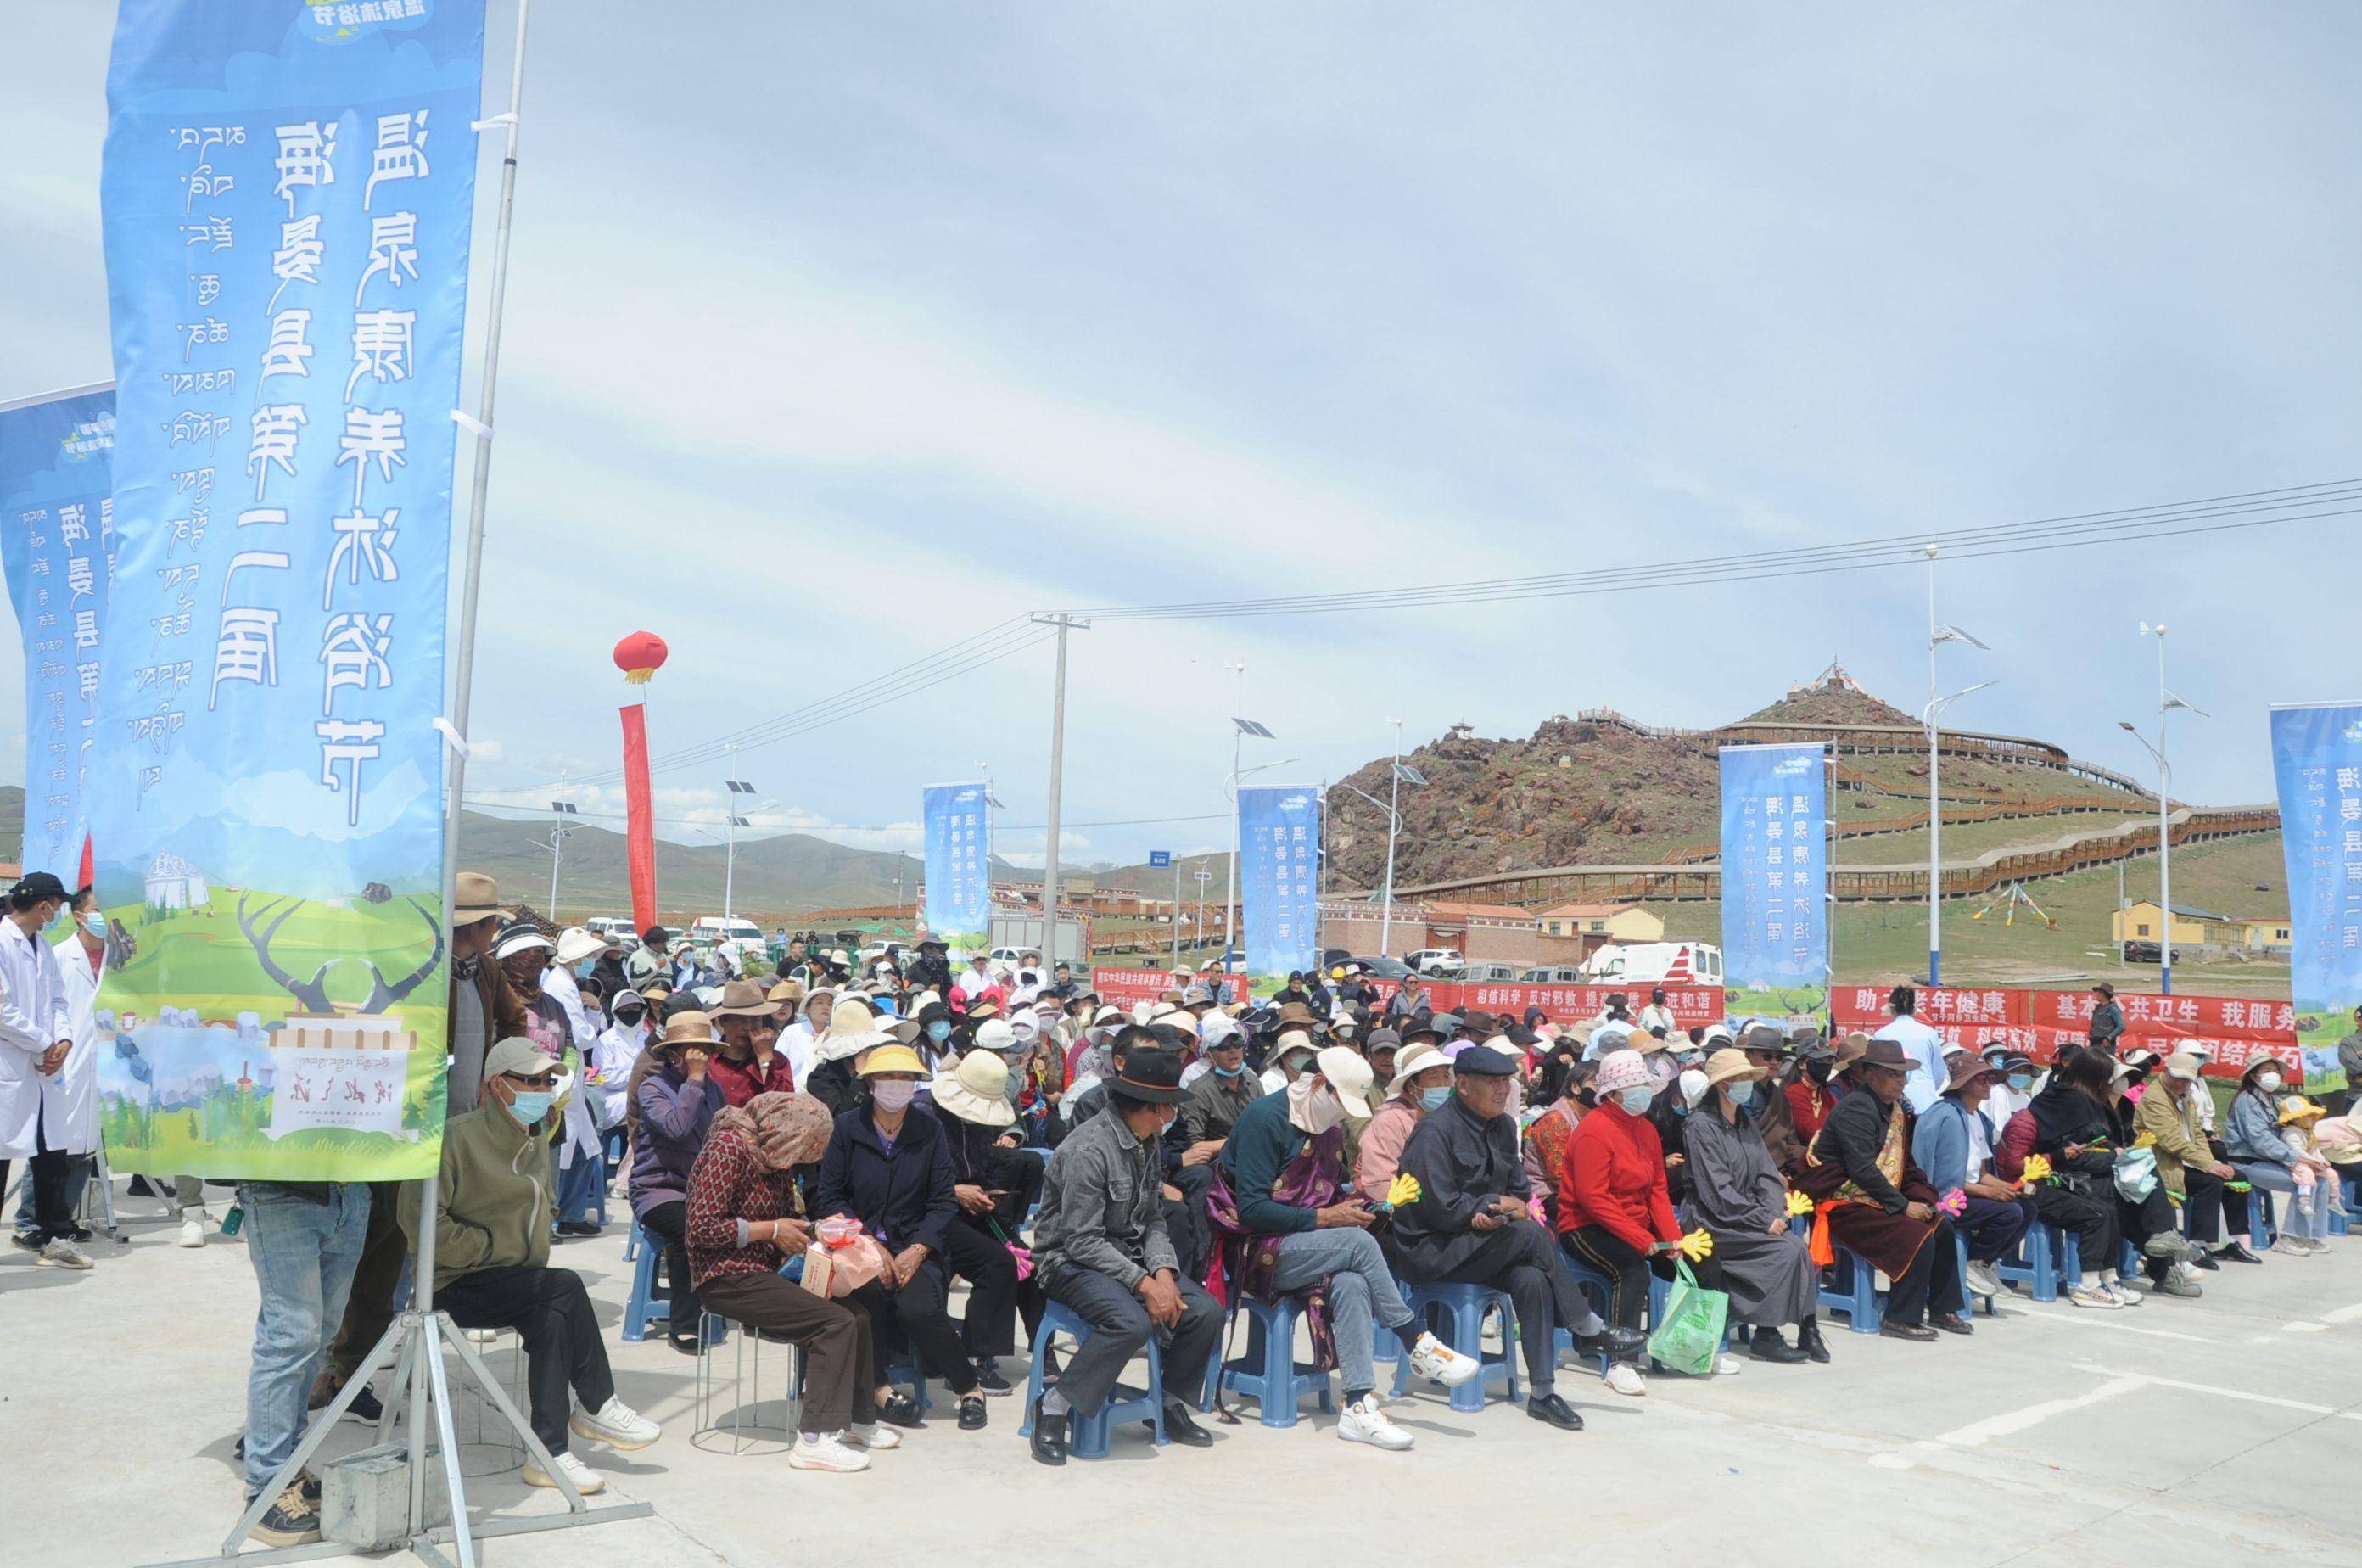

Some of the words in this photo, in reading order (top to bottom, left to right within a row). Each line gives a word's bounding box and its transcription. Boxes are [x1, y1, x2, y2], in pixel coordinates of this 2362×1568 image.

[1476, 988, 1521, 1006] 相信科学
[1528, 988, 1577, 1007] 反对邪教
[1585, 990, 1641, 1009] 提高质
[1666, 991, 1711, 1010] 进和谐
[2147, 1037, 2302, 1071] 民团结红石
